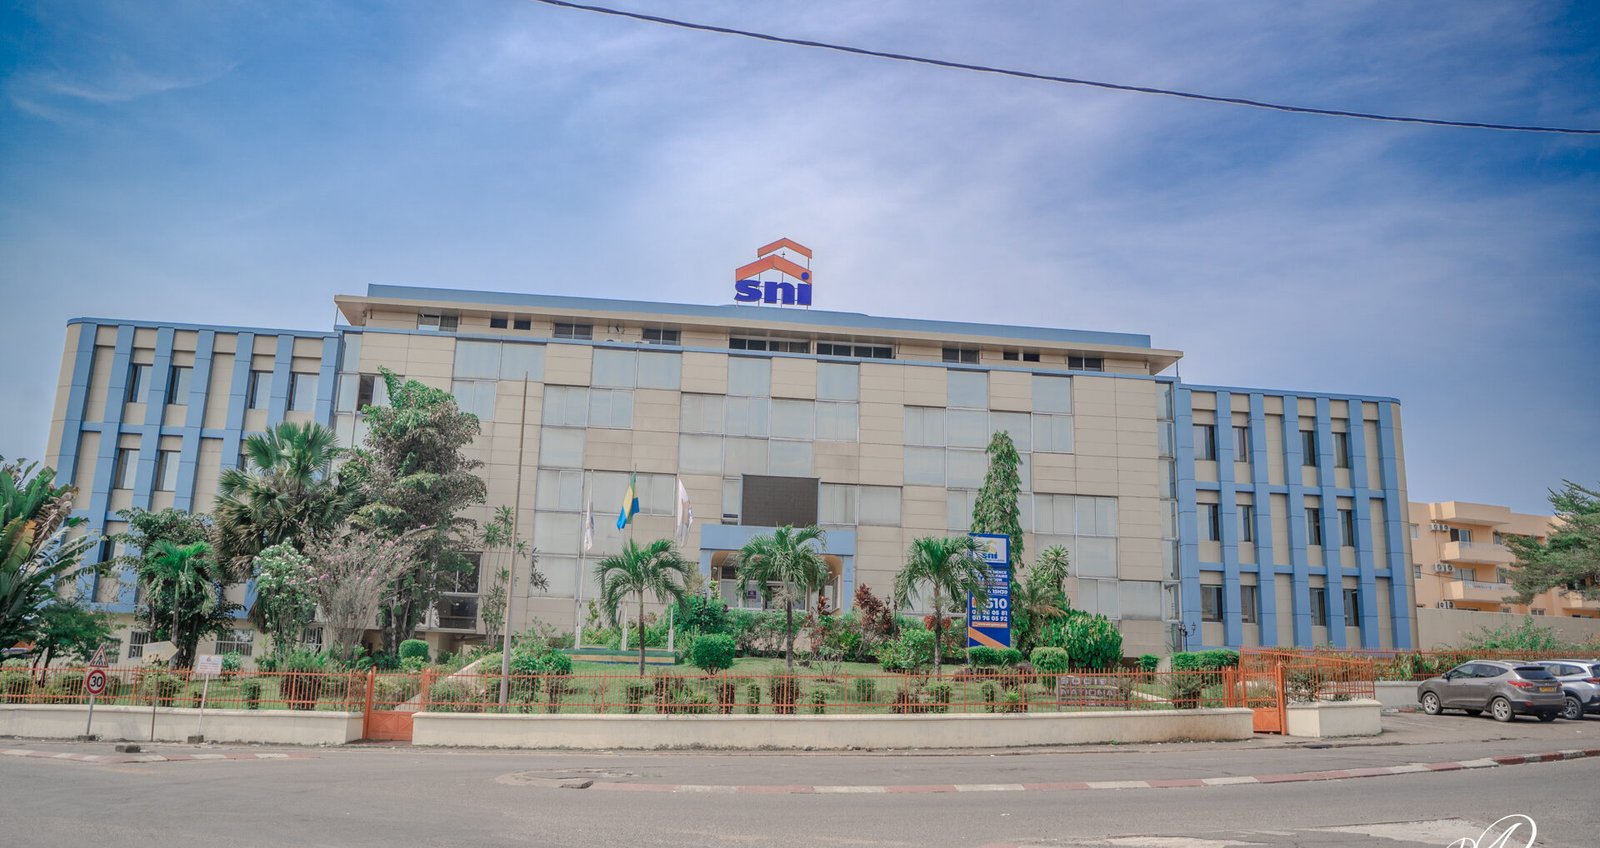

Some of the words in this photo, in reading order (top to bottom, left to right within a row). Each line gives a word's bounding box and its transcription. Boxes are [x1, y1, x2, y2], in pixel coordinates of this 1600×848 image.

[734, 272, 812, 306] sni
[90, 676, 103, 687] 30
[1060, 688, 1115, 697] NATIONA
